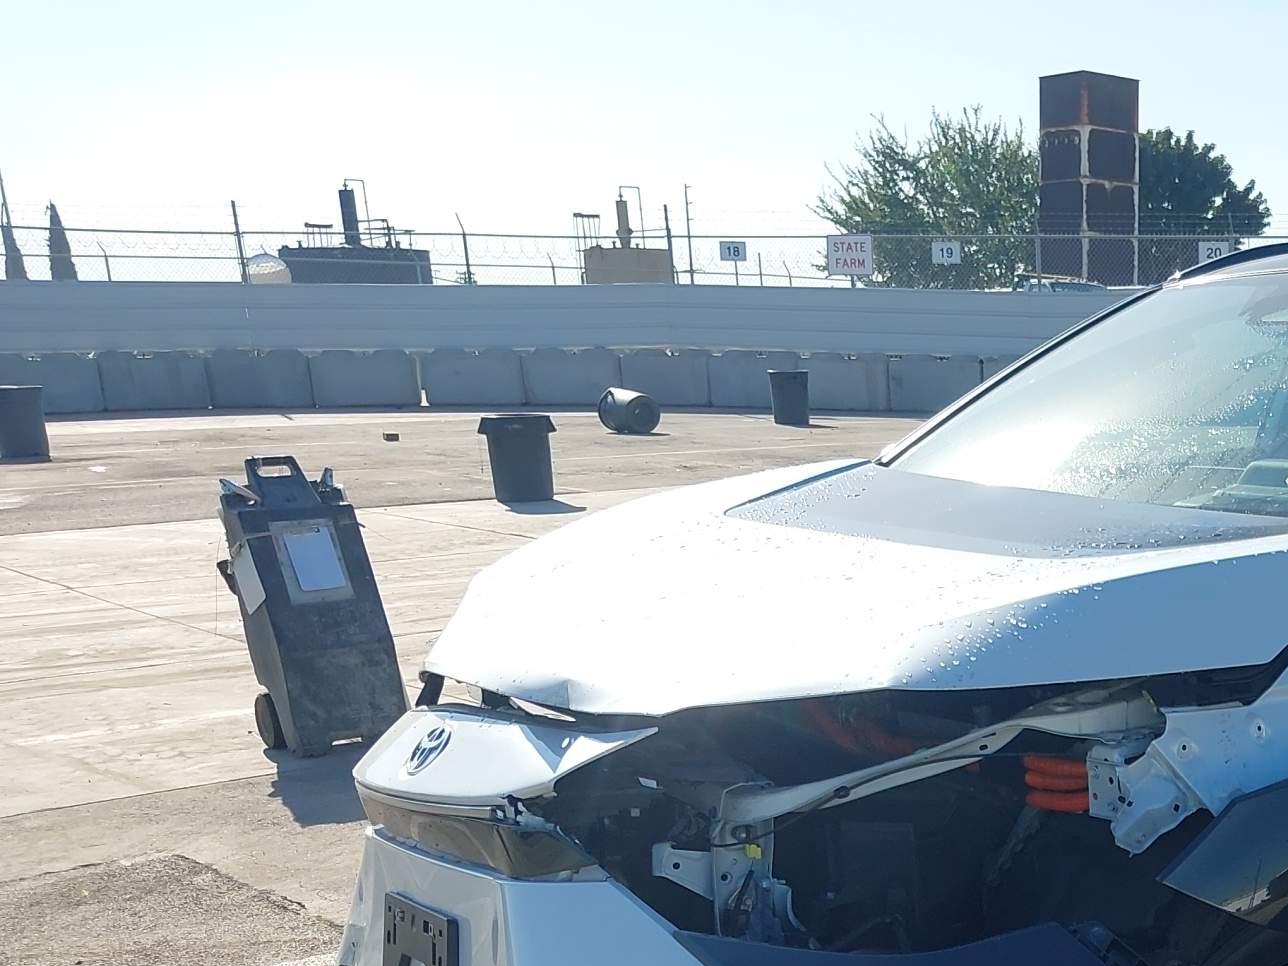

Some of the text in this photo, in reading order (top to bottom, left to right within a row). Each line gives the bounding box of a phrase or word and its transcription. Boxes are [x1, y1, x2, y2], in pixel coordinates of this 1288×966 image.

[727, 246, 740, 257] 18
[833, 242, 867, 253] STATE
[939, 247, 954, 259] 19
[1206, 247, 1222, 260] 20
[836, 257, 865, 269] FARM
